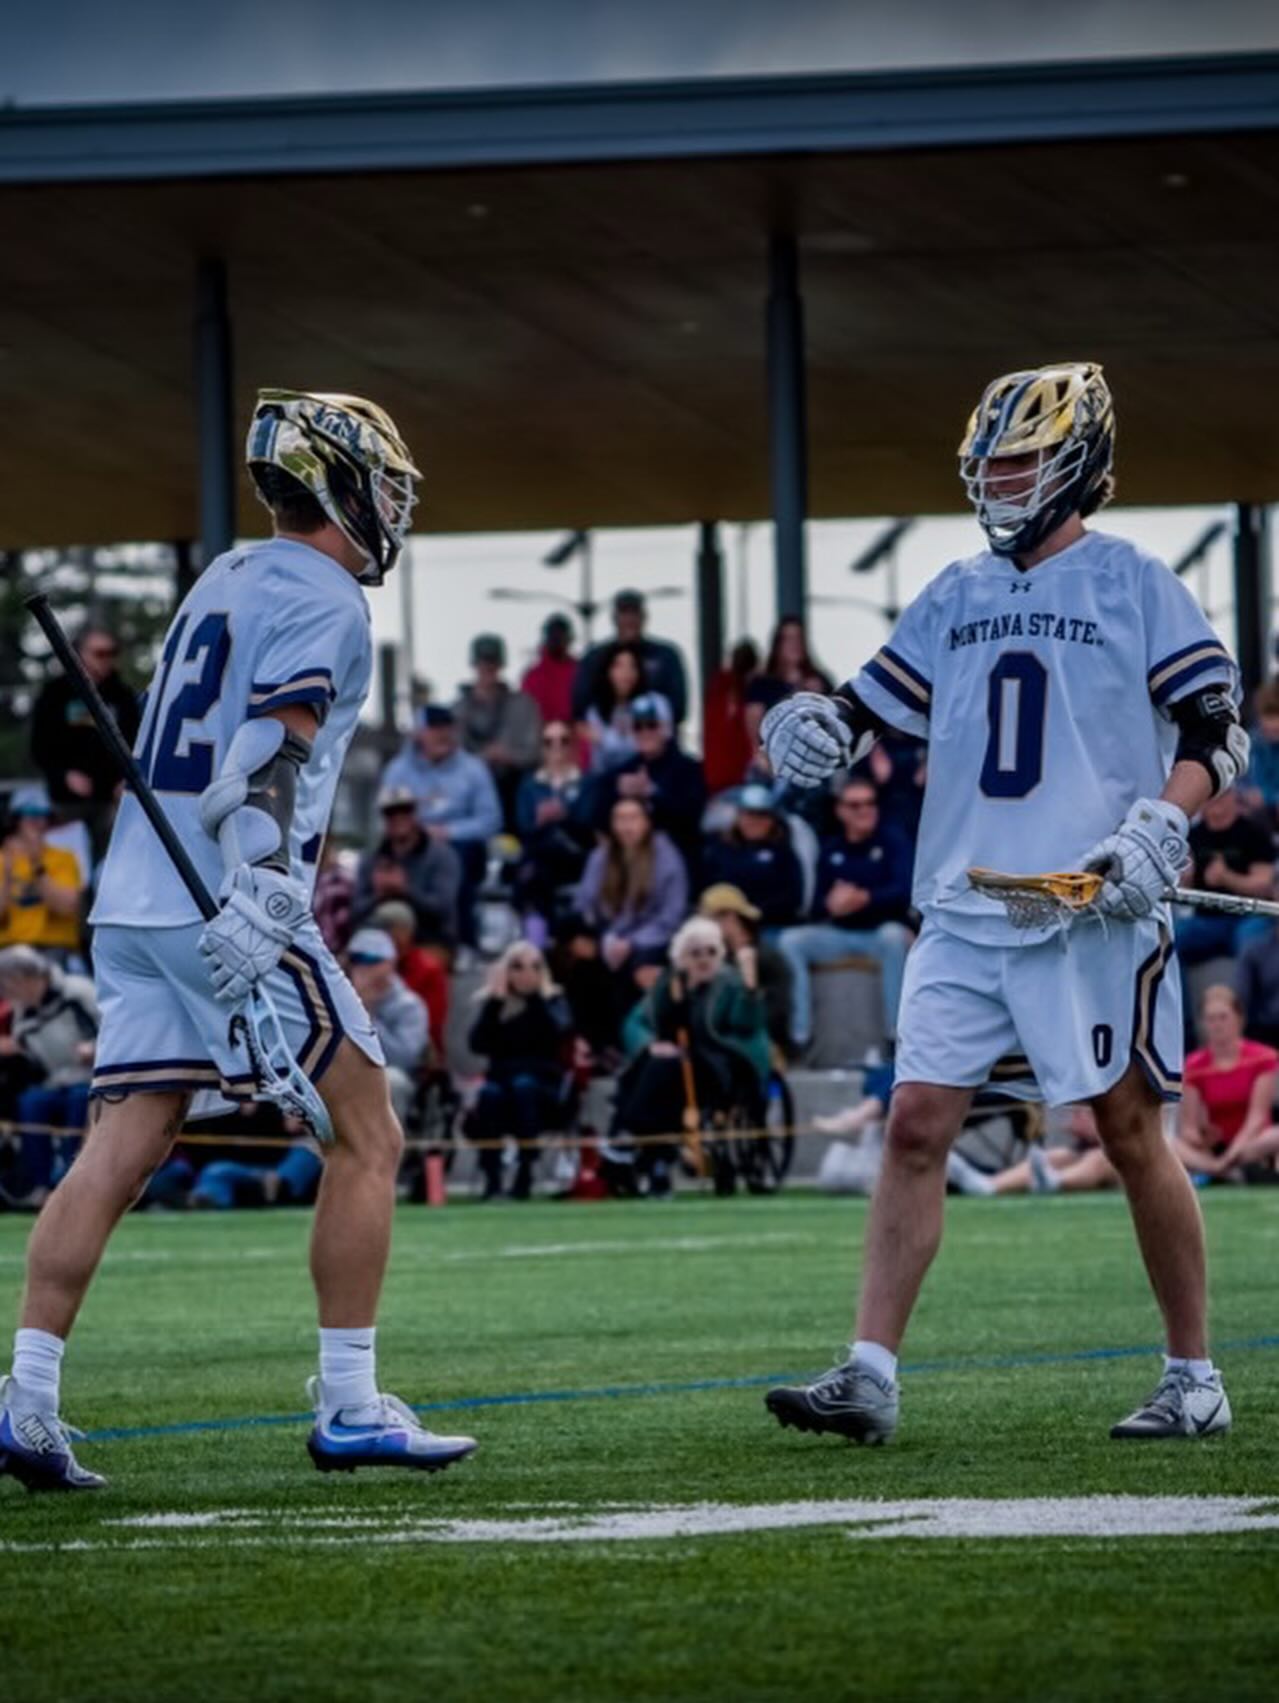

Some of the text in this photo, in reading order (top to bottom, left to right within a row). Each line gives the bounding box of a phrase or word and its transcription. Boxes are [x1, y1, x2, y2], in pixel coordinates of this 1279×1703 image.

[125, 611, 232, 794] 12
[979, 651, 1048, 800] 0
[1092, 1024, 1113, 1068] 0
[17, 1413, 56, 1455] NIKE
